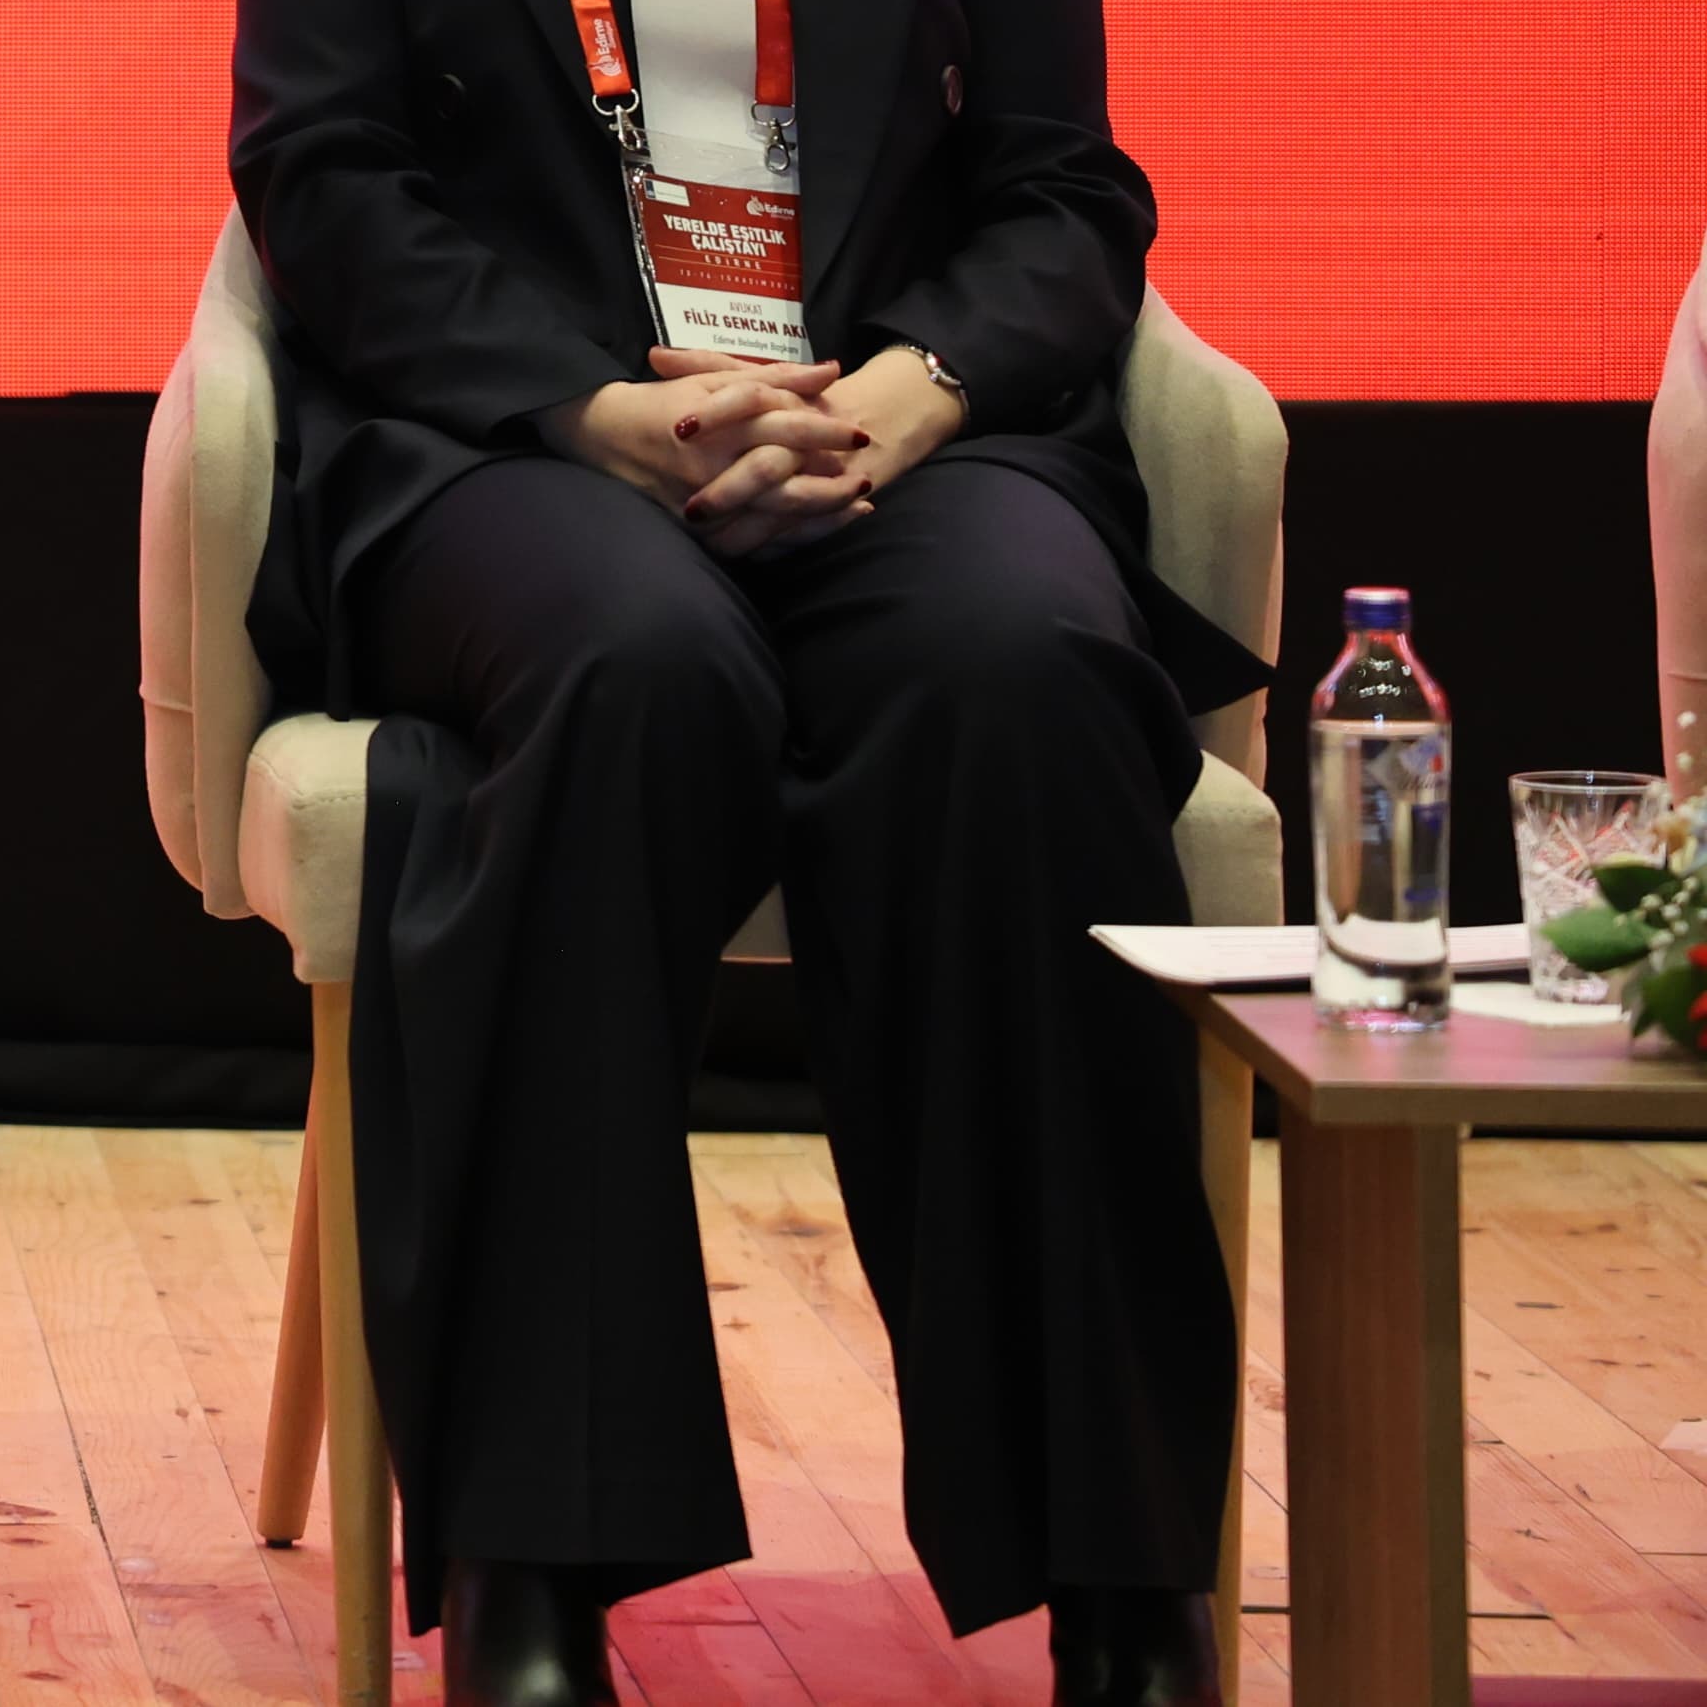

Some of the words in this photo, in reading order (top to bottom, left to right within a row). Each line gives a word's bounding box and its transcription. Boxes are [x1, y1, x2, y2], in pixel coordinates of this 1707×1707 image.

[593, 18, 611, 56] Edirne
[765, 202, 796, 217] Edirne
[663, 214, 728, 237] YERELDE
[691, 234, 767, 257] ÇALIŞTAYI
[683, 308, 719, 327] FİLİZ
[722, 315, 778, 334] GENCAN
[782, 323, 807, 339] AKI
